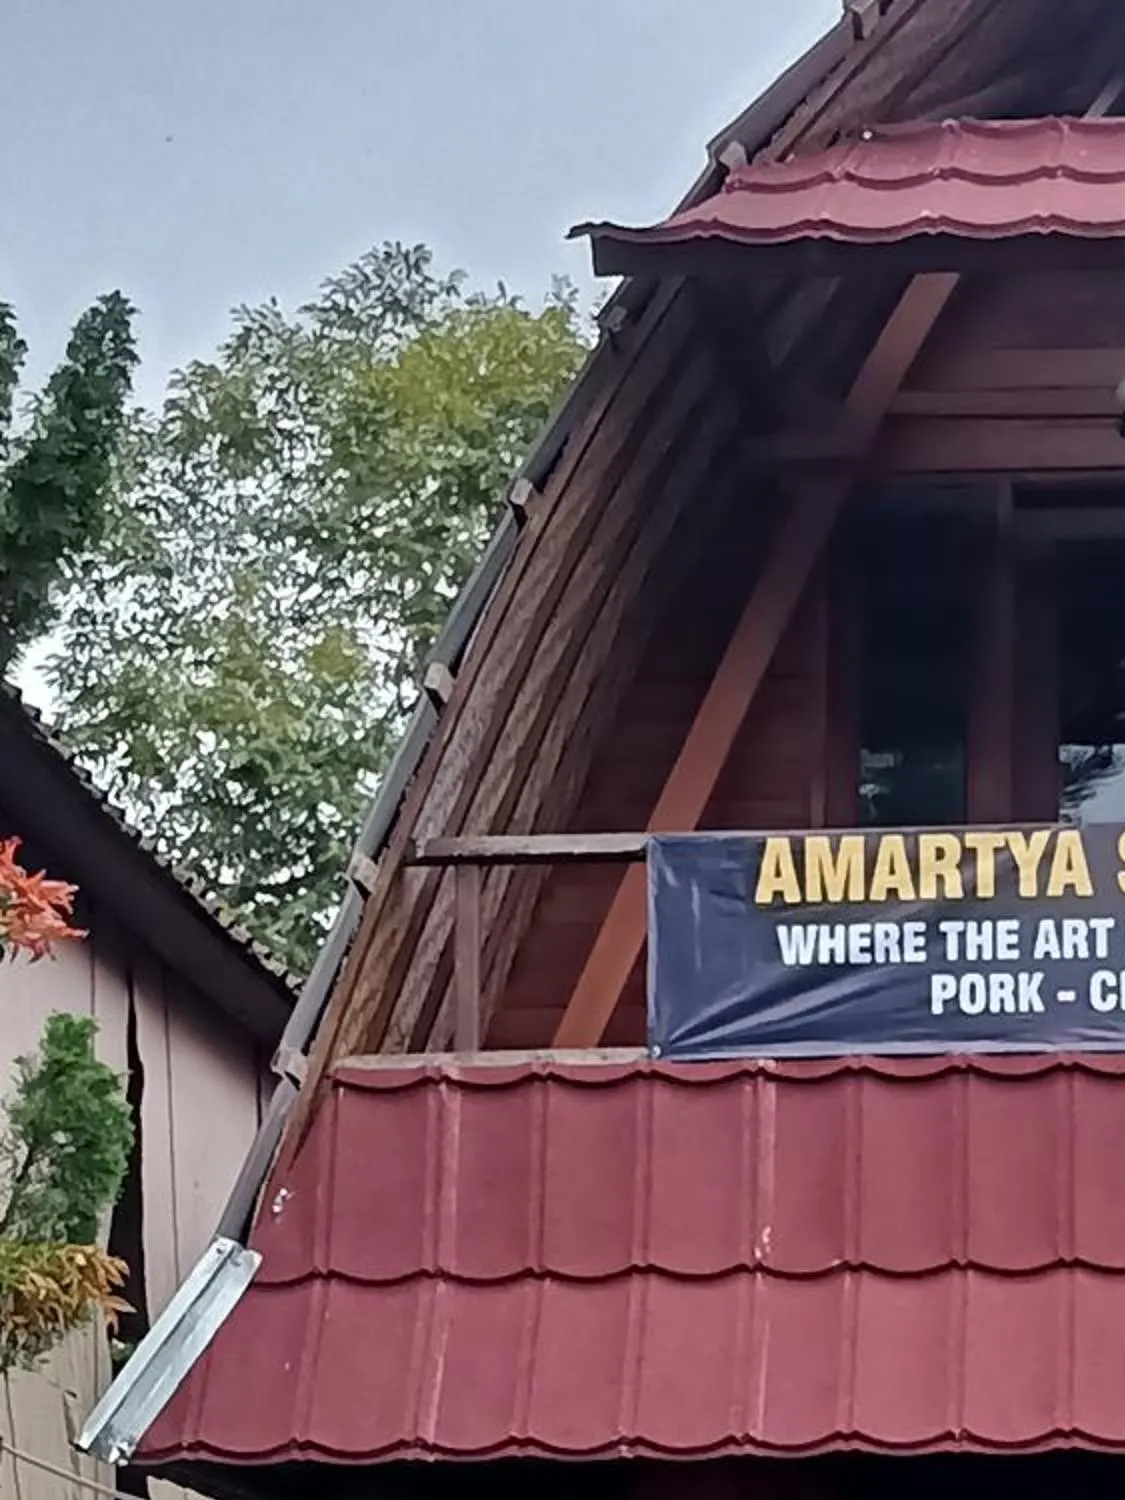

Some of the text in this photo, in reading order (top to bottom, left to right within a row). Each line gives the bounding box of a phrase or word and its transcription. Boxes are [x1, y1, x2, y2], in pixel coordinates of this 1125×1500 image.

[754, 830, 1094, 904] AMARTYA
[776, 921, 928, 966] WHERE
[938, 919, 1021, 962] THE
[1032, 917, 1116, 960] ART
[930, 971, 1046, 1016] PORK
